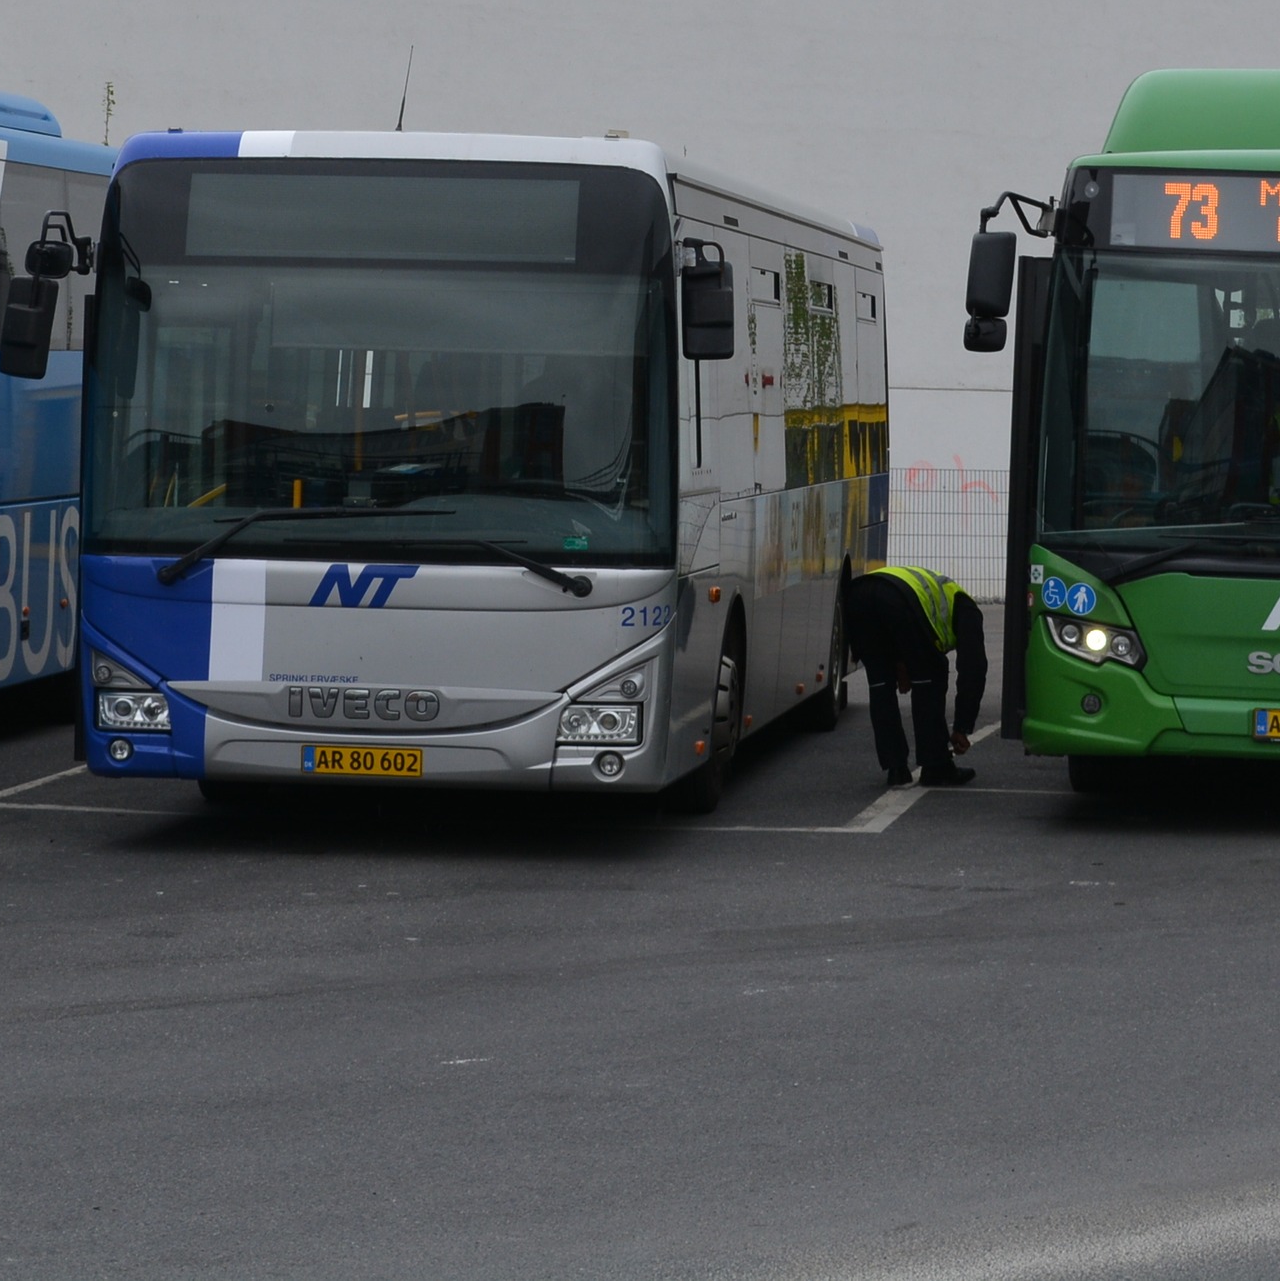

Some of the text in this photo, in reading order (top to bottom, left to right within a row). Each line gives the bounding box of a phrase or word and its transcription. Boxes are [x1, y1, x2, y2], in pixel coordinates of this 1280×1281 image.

[1163, 181, 1220, 241] 73
[307, 563, 422, 609] NT
[287, 686, 441, 721] IVECO
[316, 749, 419, 773] AR 80 602
